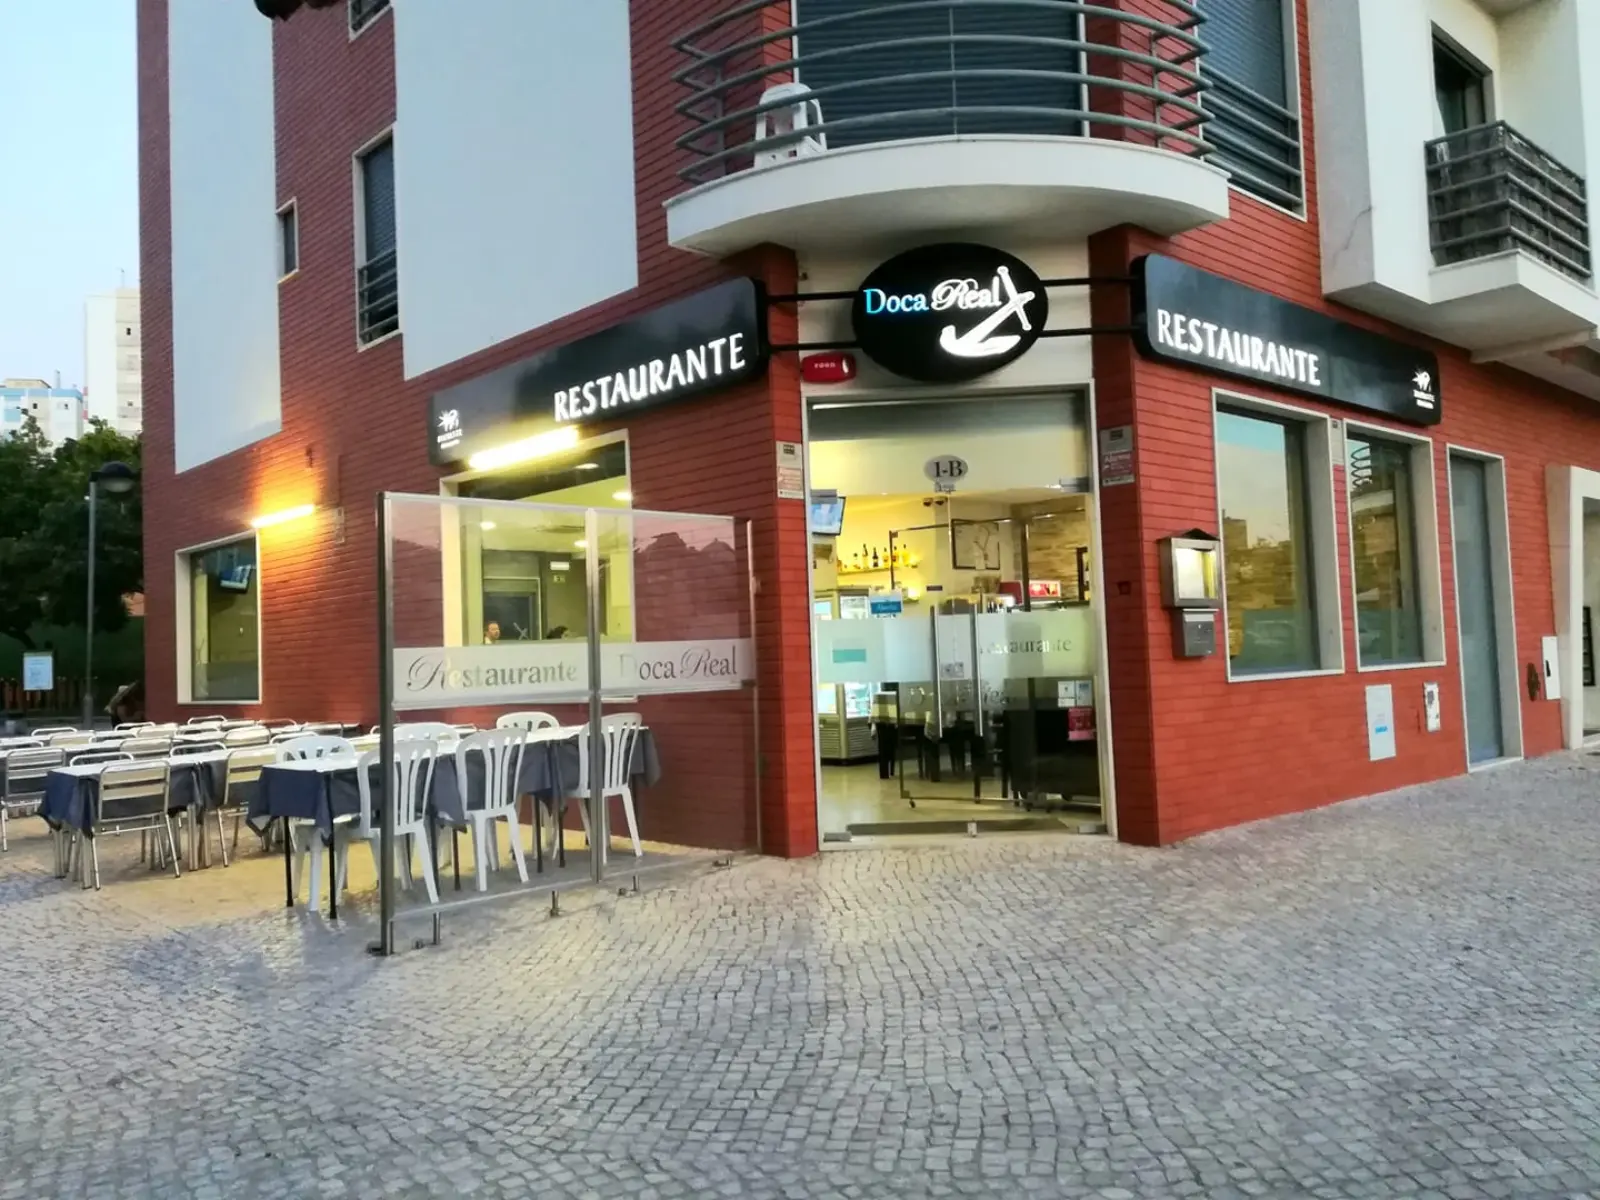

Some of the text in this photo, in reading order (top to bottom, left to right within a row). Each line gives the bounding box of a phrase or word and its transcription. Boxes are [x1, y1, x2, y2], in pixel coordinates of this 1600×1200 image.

[862, 277, 1002, 315] Doca Real
[553, 332, 746, 423] RESTAURANTE
[1156, 308, 1321, 387] RESTAURANTE
[406, 645, 738, 692] Restaurante Doca Real
